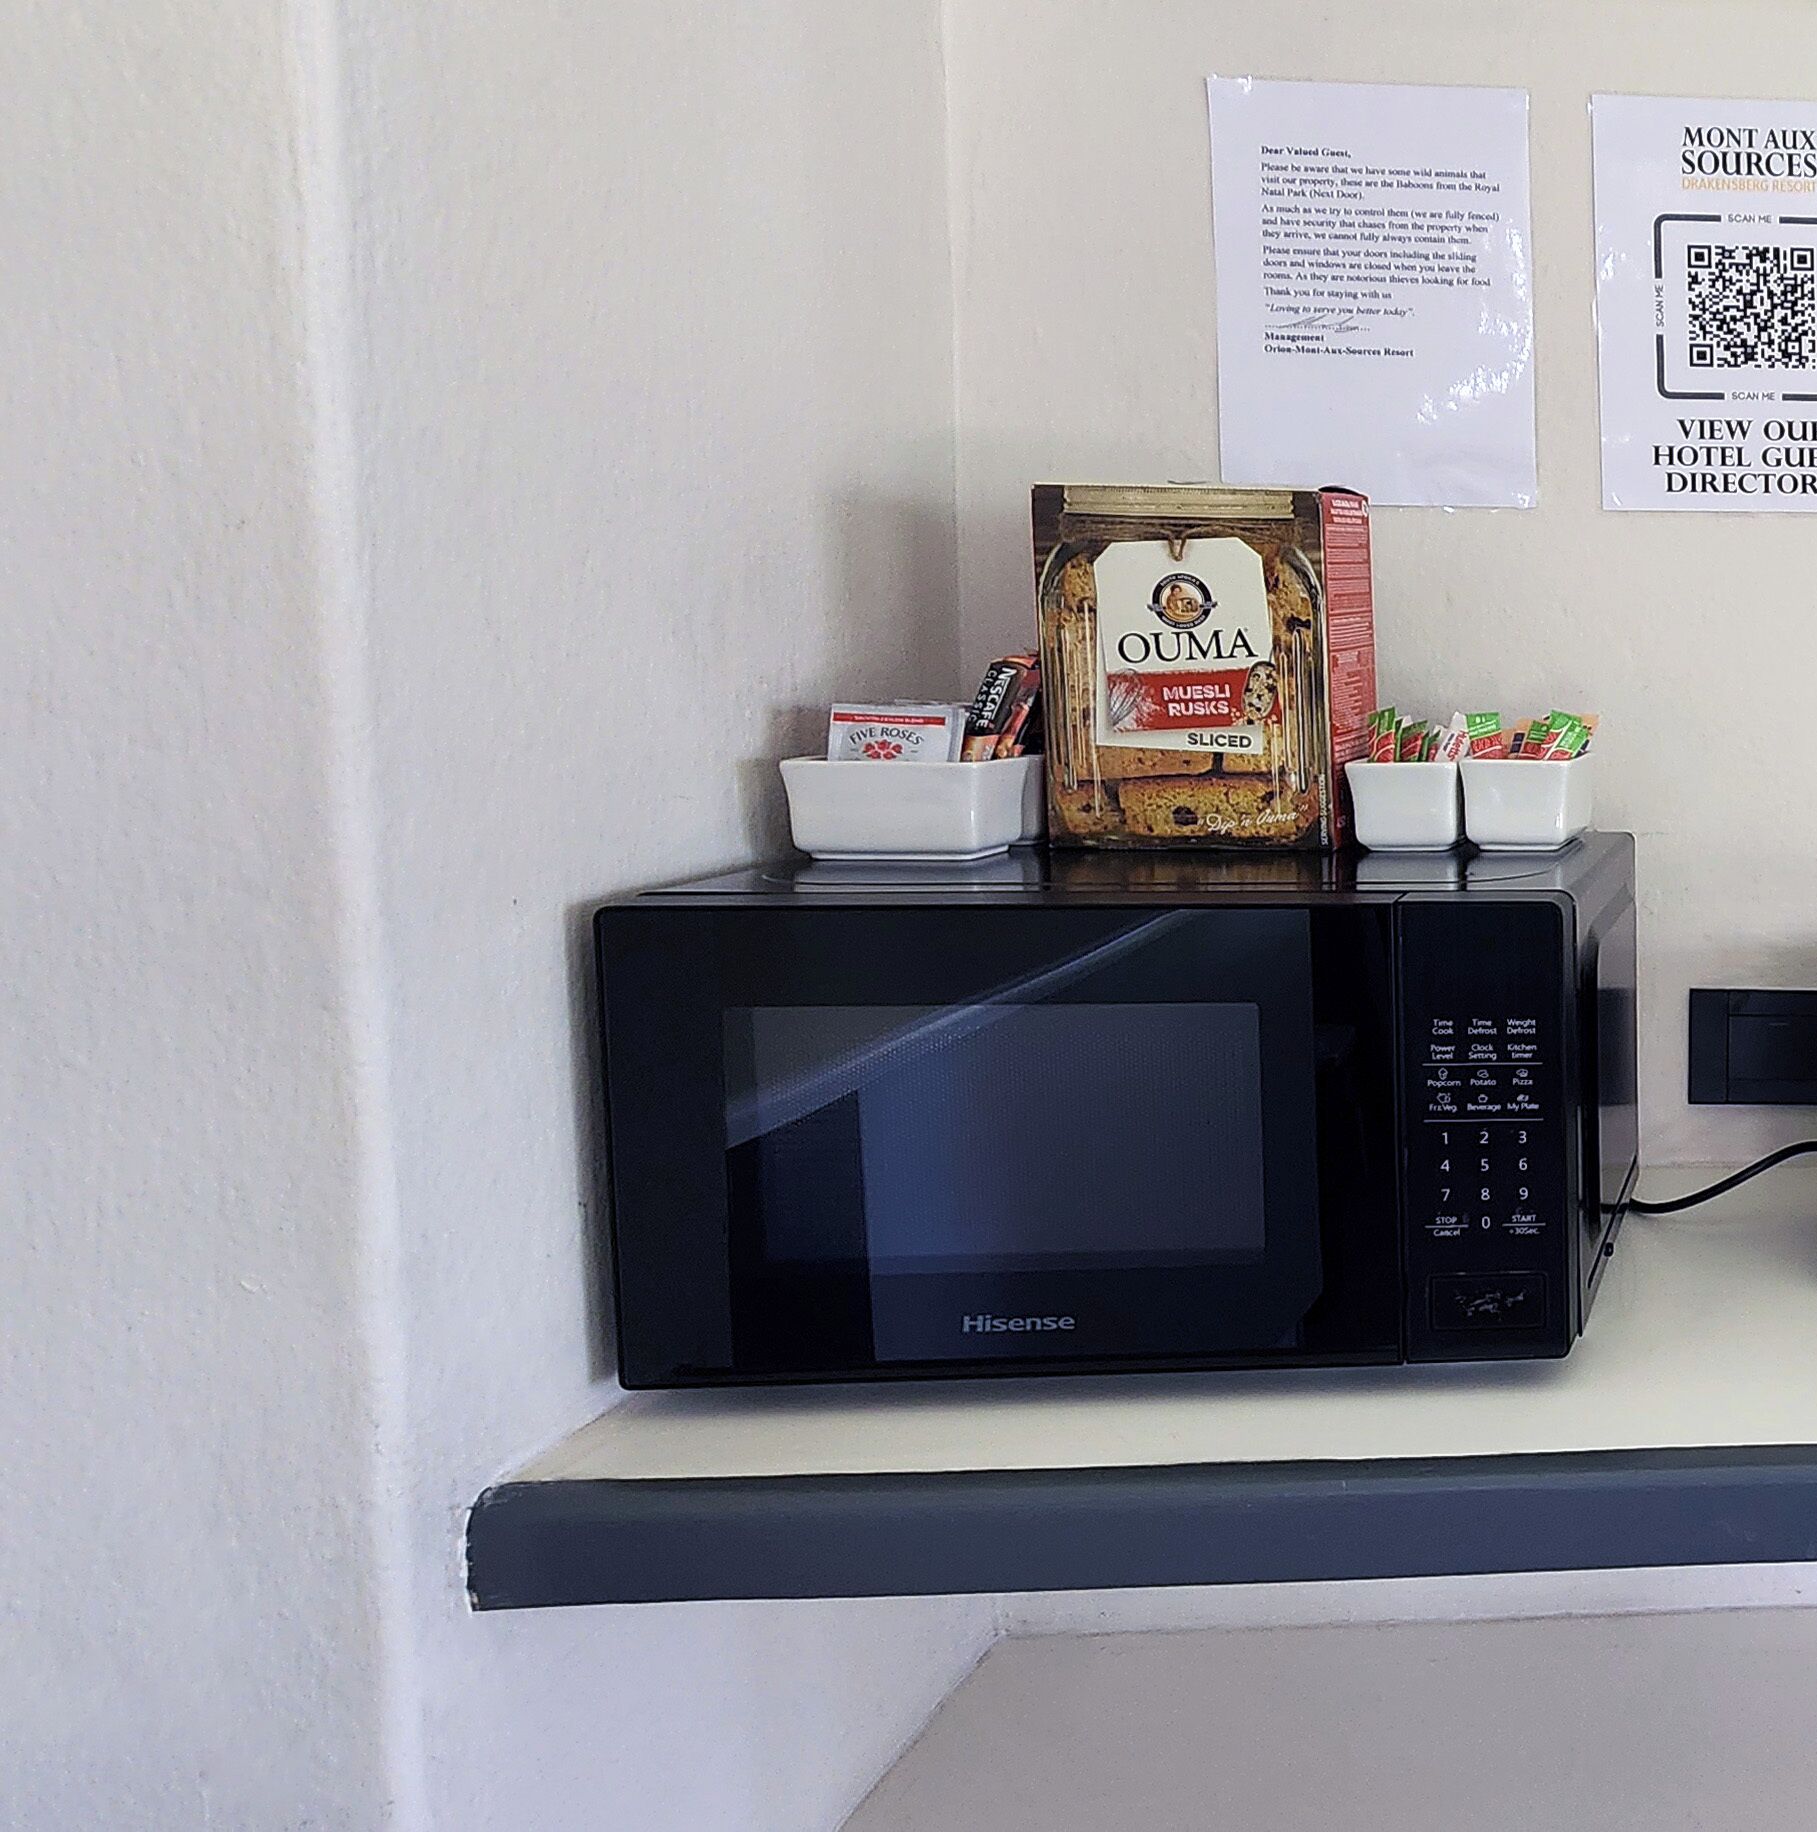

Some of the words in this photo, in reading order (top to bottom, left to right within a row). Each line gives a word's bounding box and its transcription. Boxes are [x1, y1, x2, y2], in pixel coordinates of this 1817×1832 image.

[1683, 126, 1758, 148] MONT
[1764, 128, 1816, 150] AUX
[1261, 146, 1284, 155] Dear
[1287, 146, 1318, 156] Valued
[1322, 147, 1351, 158] Guest,
[1682, 150, 1817, 177] SOURCES
[1261, 163, 1288, 172] Please
[1291, 163, 1301, 172] be
[1304, 166, 1329, 174] aware
[1332, 165, 1348, 174] that
[1366, 166, 1386, 175] have
[1413, 168, 1432, 177] wild
[1435, 169, 1467, 178] animals
[1470, 170, 1486, 179] that
[1262, 176, 1279, 184] visit
[1299, 177, 1337, 187] property,
[1341, 178, 1362, 186] these
[1381, 178, 1394, 187] the
[1396, 179, 1433, 189] Baboons
[1436, 181, 1456, 190] from
[1459, 182, 1472, 190] the
[1475, 183, 1499, 193] Royal
[1682, 179, 1769, 191] DRAKENSBERG
[1772, 180, 1817, 192] RESORT
[1262, 188, 1284, 197] Natal
[1287, 188, 1307, 197] Park
[1310, 189, 1334, 200] (Next
[1337, 190, 1364, 200] Door).
[1262, 205, 1274, 213] As
[1276, 205, 1300, 213] much
[1329, 208, 1342, 217] try
[1355, 208, 1385, 216] control
[1388, 208, 1408, 217] them
[1411, 209, 1426, 220] (we
[1446, 210, 1465, 221] fully
[1468, 211, 1499, 221] fenced)
[1728, 214, 1755, 223] SCAN
[1759, 215, 1772, 223] ME
[1262, 217, 1277, 225] and
[1280, 217, 1300, 226] have
[1303, 218, 1336, 229] security
[1339, 219, 1355, 228] that
[1358, 220, 1386, 229] chases
[1389, 220, 1409, 230] from
[1411, 221, 1424, 230] the
[1427, 223, 1462, 234] property
[1465, 224, 1488, 232] when
[1262, 229, 1281, 239] they
[1284, 230, 1311, 239] arrive,
[1329, 231, 1357, 240] cannot
[1360, 231, 1380, 243] fully
[1383, 232, 1412, 244] always
[1414, 234, 1445, 243] contain
[1448, 235, 1471, 244] them.
[1263, 245, 1290, 254] Please
[1293, 248, 1321, 256] ensure
[1324, 247, 1339, 256] that
[1342, 250, 1361, 259] your
[1364, 249, 1387, 258] doors
[1390, 250, 1430, 261] including
[1433, 251, 1445, 260] the
[1448, 251, 1476, 262] sliding
[1263, 259, 1287, 267] doors
[1290, 259, 1305, 268] and
[1308, 259, 1346, 269] windows
[1365, 261, 1391, 270] closed
[1394, 262, 1416, 271] when
[1419, 264, 1435, 274] you
[1438, 263, 1460, 272] leave
[1463, 263, 1475, 273] the
[1296, 272, 1307, 280] As
[1310, 272, 1328, 282] they
[1347, 274, 1387, 283] notorious
[1390, 275, 1419, 284] thieves
[1422, 275, 1454, 286] looking
[1456, 276, 1468, 286] for
[1471, 277, 1491, 286] food
[1265, 287, 1291, 296] Thank
[1293, 290, 1310, 299] you
[1313, 288, 1325, 297] for
[1328, 290, 1358, 300] staying
[1361, 290, 1379, 299] with
[1656, 284, 1664, 298] ME
[1656, 301, 1664, 327] SCAN
[1265, 332, 1324, 342] Management
[1384, 347, 1414, 357] Resort
[1732, 392, 1759, 400] SCAN
[1762, 392, 1775, 401] ME
[1677, 419, 1752, 440] VIEW
[1653, 446, 1751, 467] HOTEL
[1118, 628, 1259, 663] OUMA
[968, 670, 997, 722] CLASSIC
[1163, 684, 1230, 700] MUESLI
[1168, 701, 1229, 716] RUSKS
[849, 728, 875, 745] FIVE
[881, 727, 924, 745] ROSES
[1187, 733, 1252, 748] SLICED
[1507, 1019, 1536, 1027] Weight
[1432, 1027, 1454, 1035] Cook
[1468, 1027, 1497, 1035] Defrost
[1507, 1027, 1536, 1035] Defrost
[1432, 1052, 1453, 1060] Level
[1469, 1052, 1497, 1060] Setting
[1427, 1080, 1461, 1088] Popcorn
[1467, 1103, 1501, 1112] Beverage
[1507, 1103, 1519, 1111] My
[1442, 1133, 1448, 1144] 1
[1479, 1132, 1488, 1144] 2
[1518, 1131, 1527, 1144] 3
[1440, 1160, 1450, 1172] 4
[1481, 1159, 1489, 1171] 5
[1519, 1158, 1528, 1170] 6
[1441, 1189, 1450, 1201] 7
[1481, 1188, 1490, 1200] 8
[1519, 1187, 1528, 1200] 9
[1482, 1217, 1490, 1229] 0
[962, 1315, 1075, 1333] Hisense
